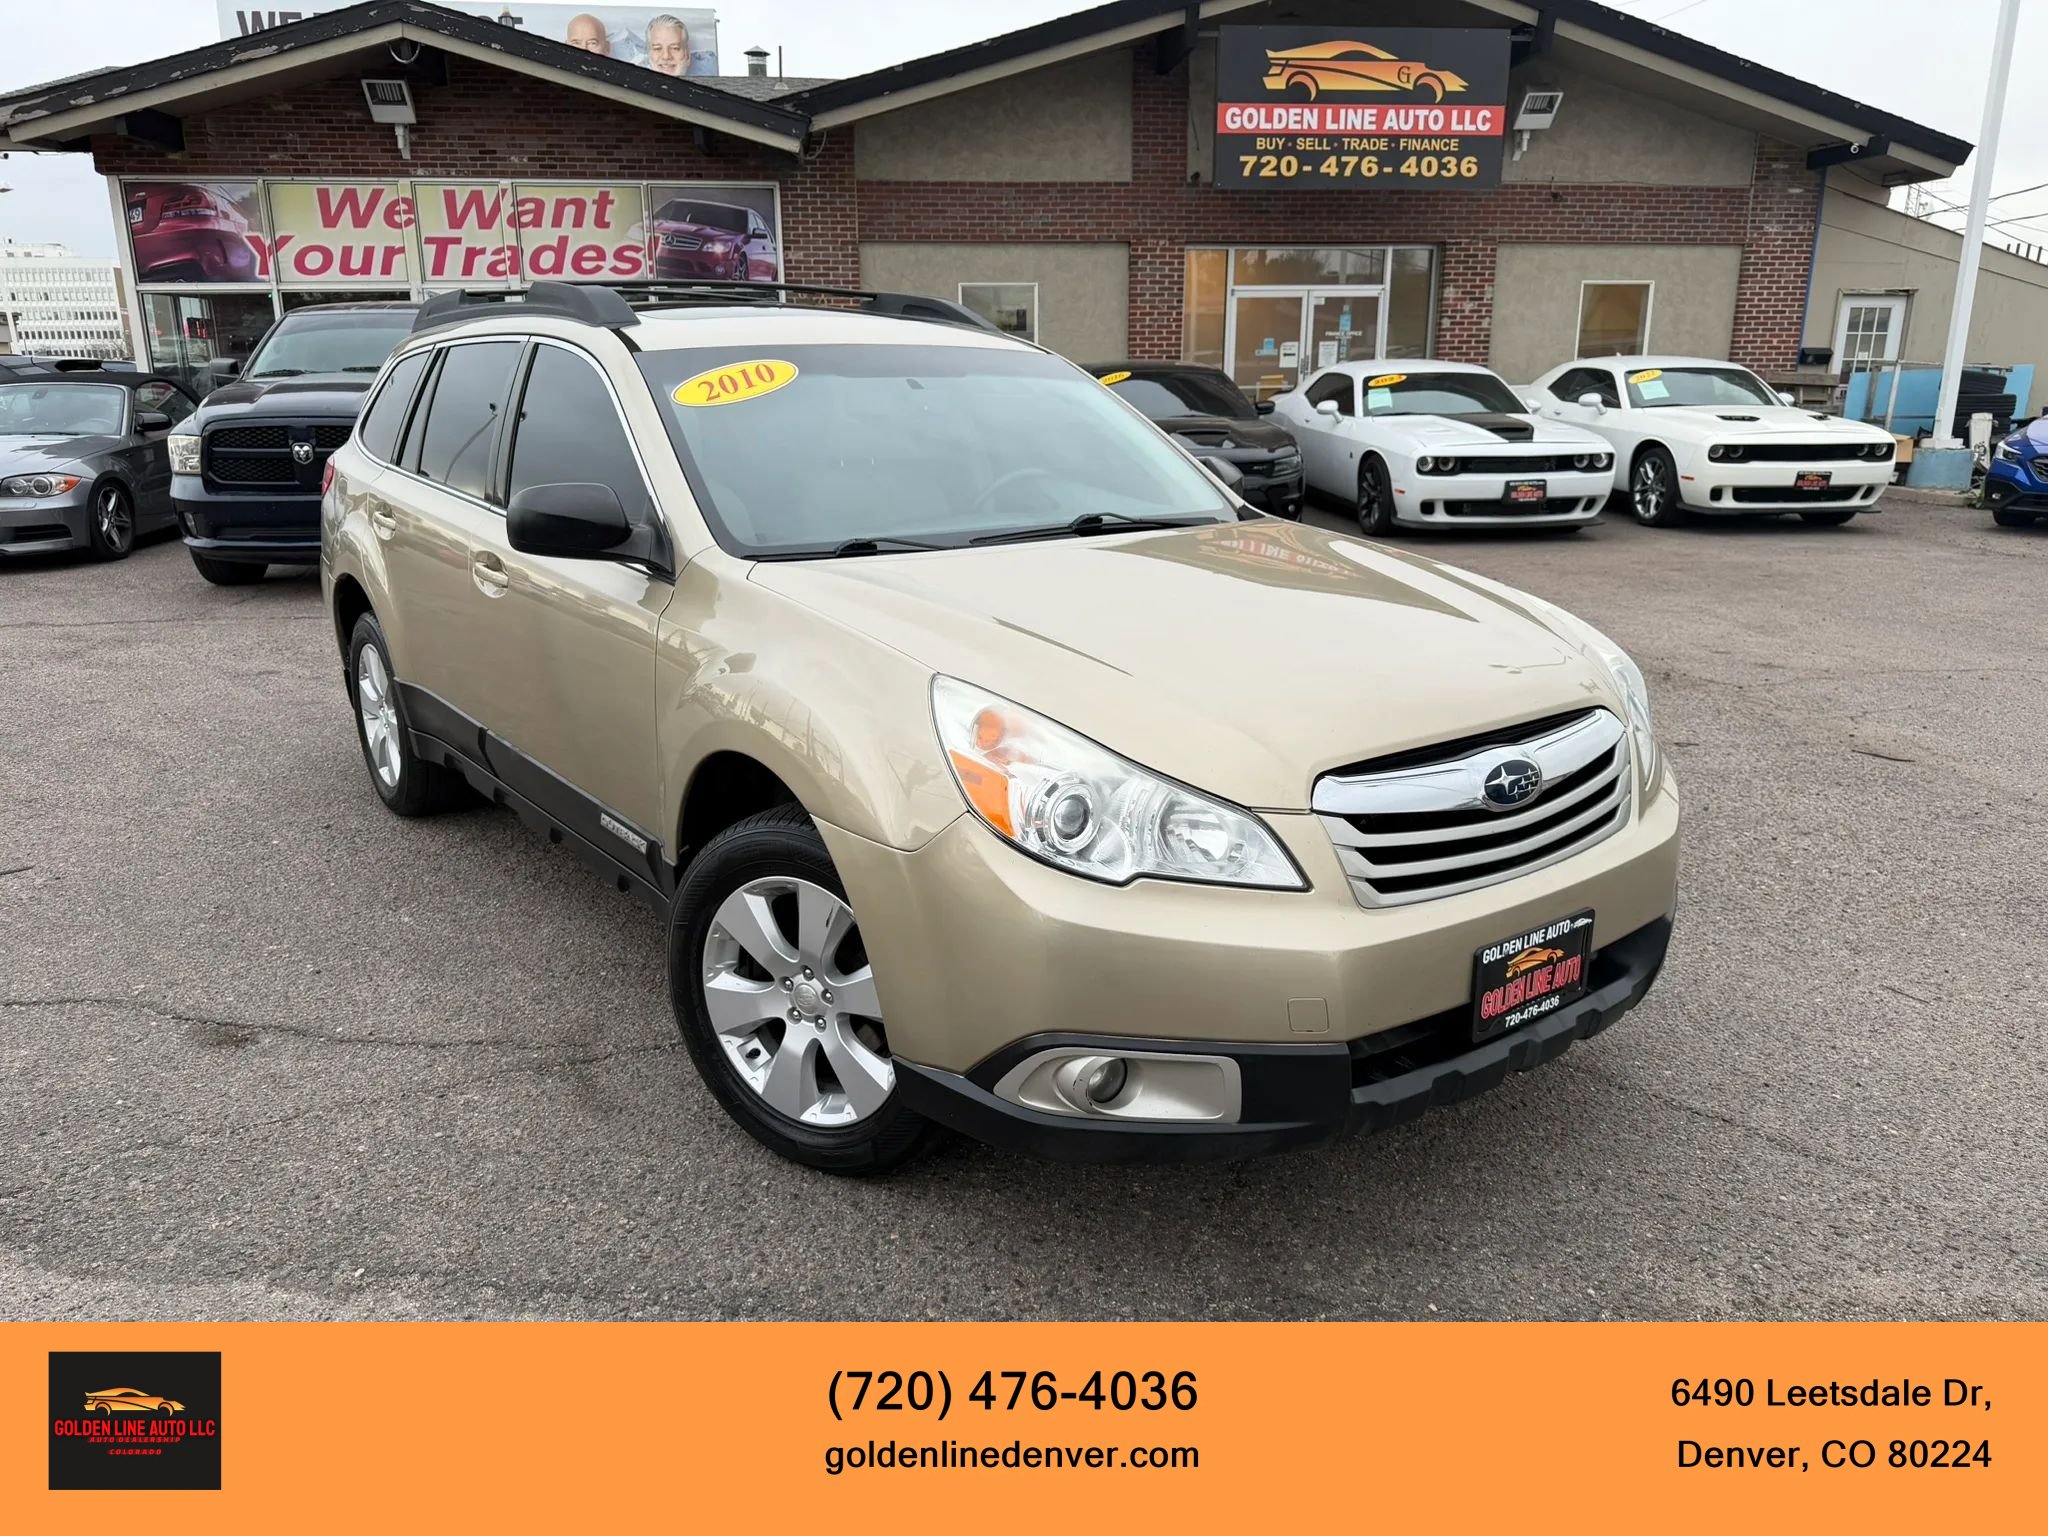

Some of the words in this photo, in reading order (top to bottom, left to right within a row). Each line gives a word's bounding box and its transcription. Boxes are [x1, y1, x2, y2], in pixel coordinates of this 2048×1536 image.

[1225, 107, 1318, 131] GOLDEN
[1325, 109, 1377, 131] LINE
[1382, 109, 1444, 131] AUTO
[1450, 110, 1492, 132] LLC
[1256, 137, 1285, 150] BUY
[1296, 138, 1331, 150] SELL
[1342, 138, 1388, 151] TRADE
[1399, 138, 1460, 151] FINANCE
[316, 187, 415, 230] We
[443, 188, 615, 231] Want
[245, 234, 405, 277] Your
[697, 363, 775, 402] 2010
[1523, 929, 1545, 950] LINE
[1546, 919, 1571, 941] AUTO
[1481, 974, 1526, 1020] GOLDEN
[1526, 965, 1553, 1000] LINE
[1552, 954, 1581, 989] AUTO
[1505, 995, 1560, 1028] 720-476-4036
